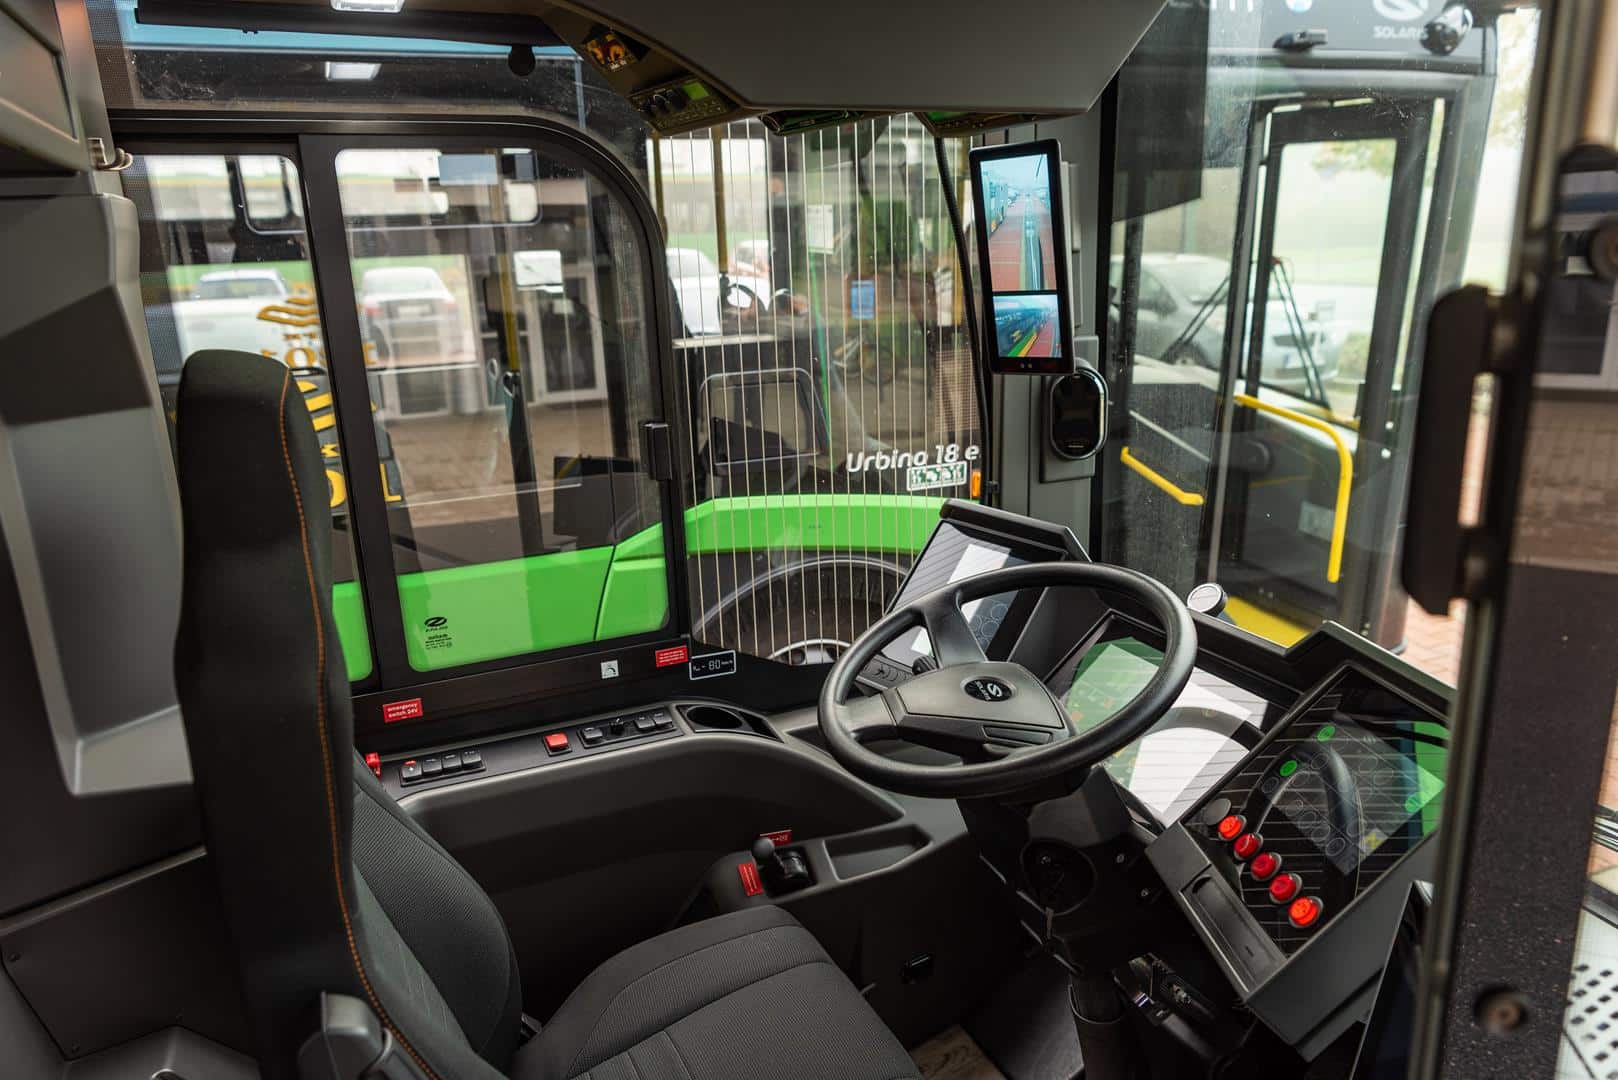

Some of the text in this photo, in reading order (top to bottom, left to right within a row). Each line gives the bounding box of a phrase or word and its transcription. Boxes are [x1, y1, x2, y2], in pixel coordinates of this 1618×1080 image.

[846, 443, 980, 472] Urbino 18 e
